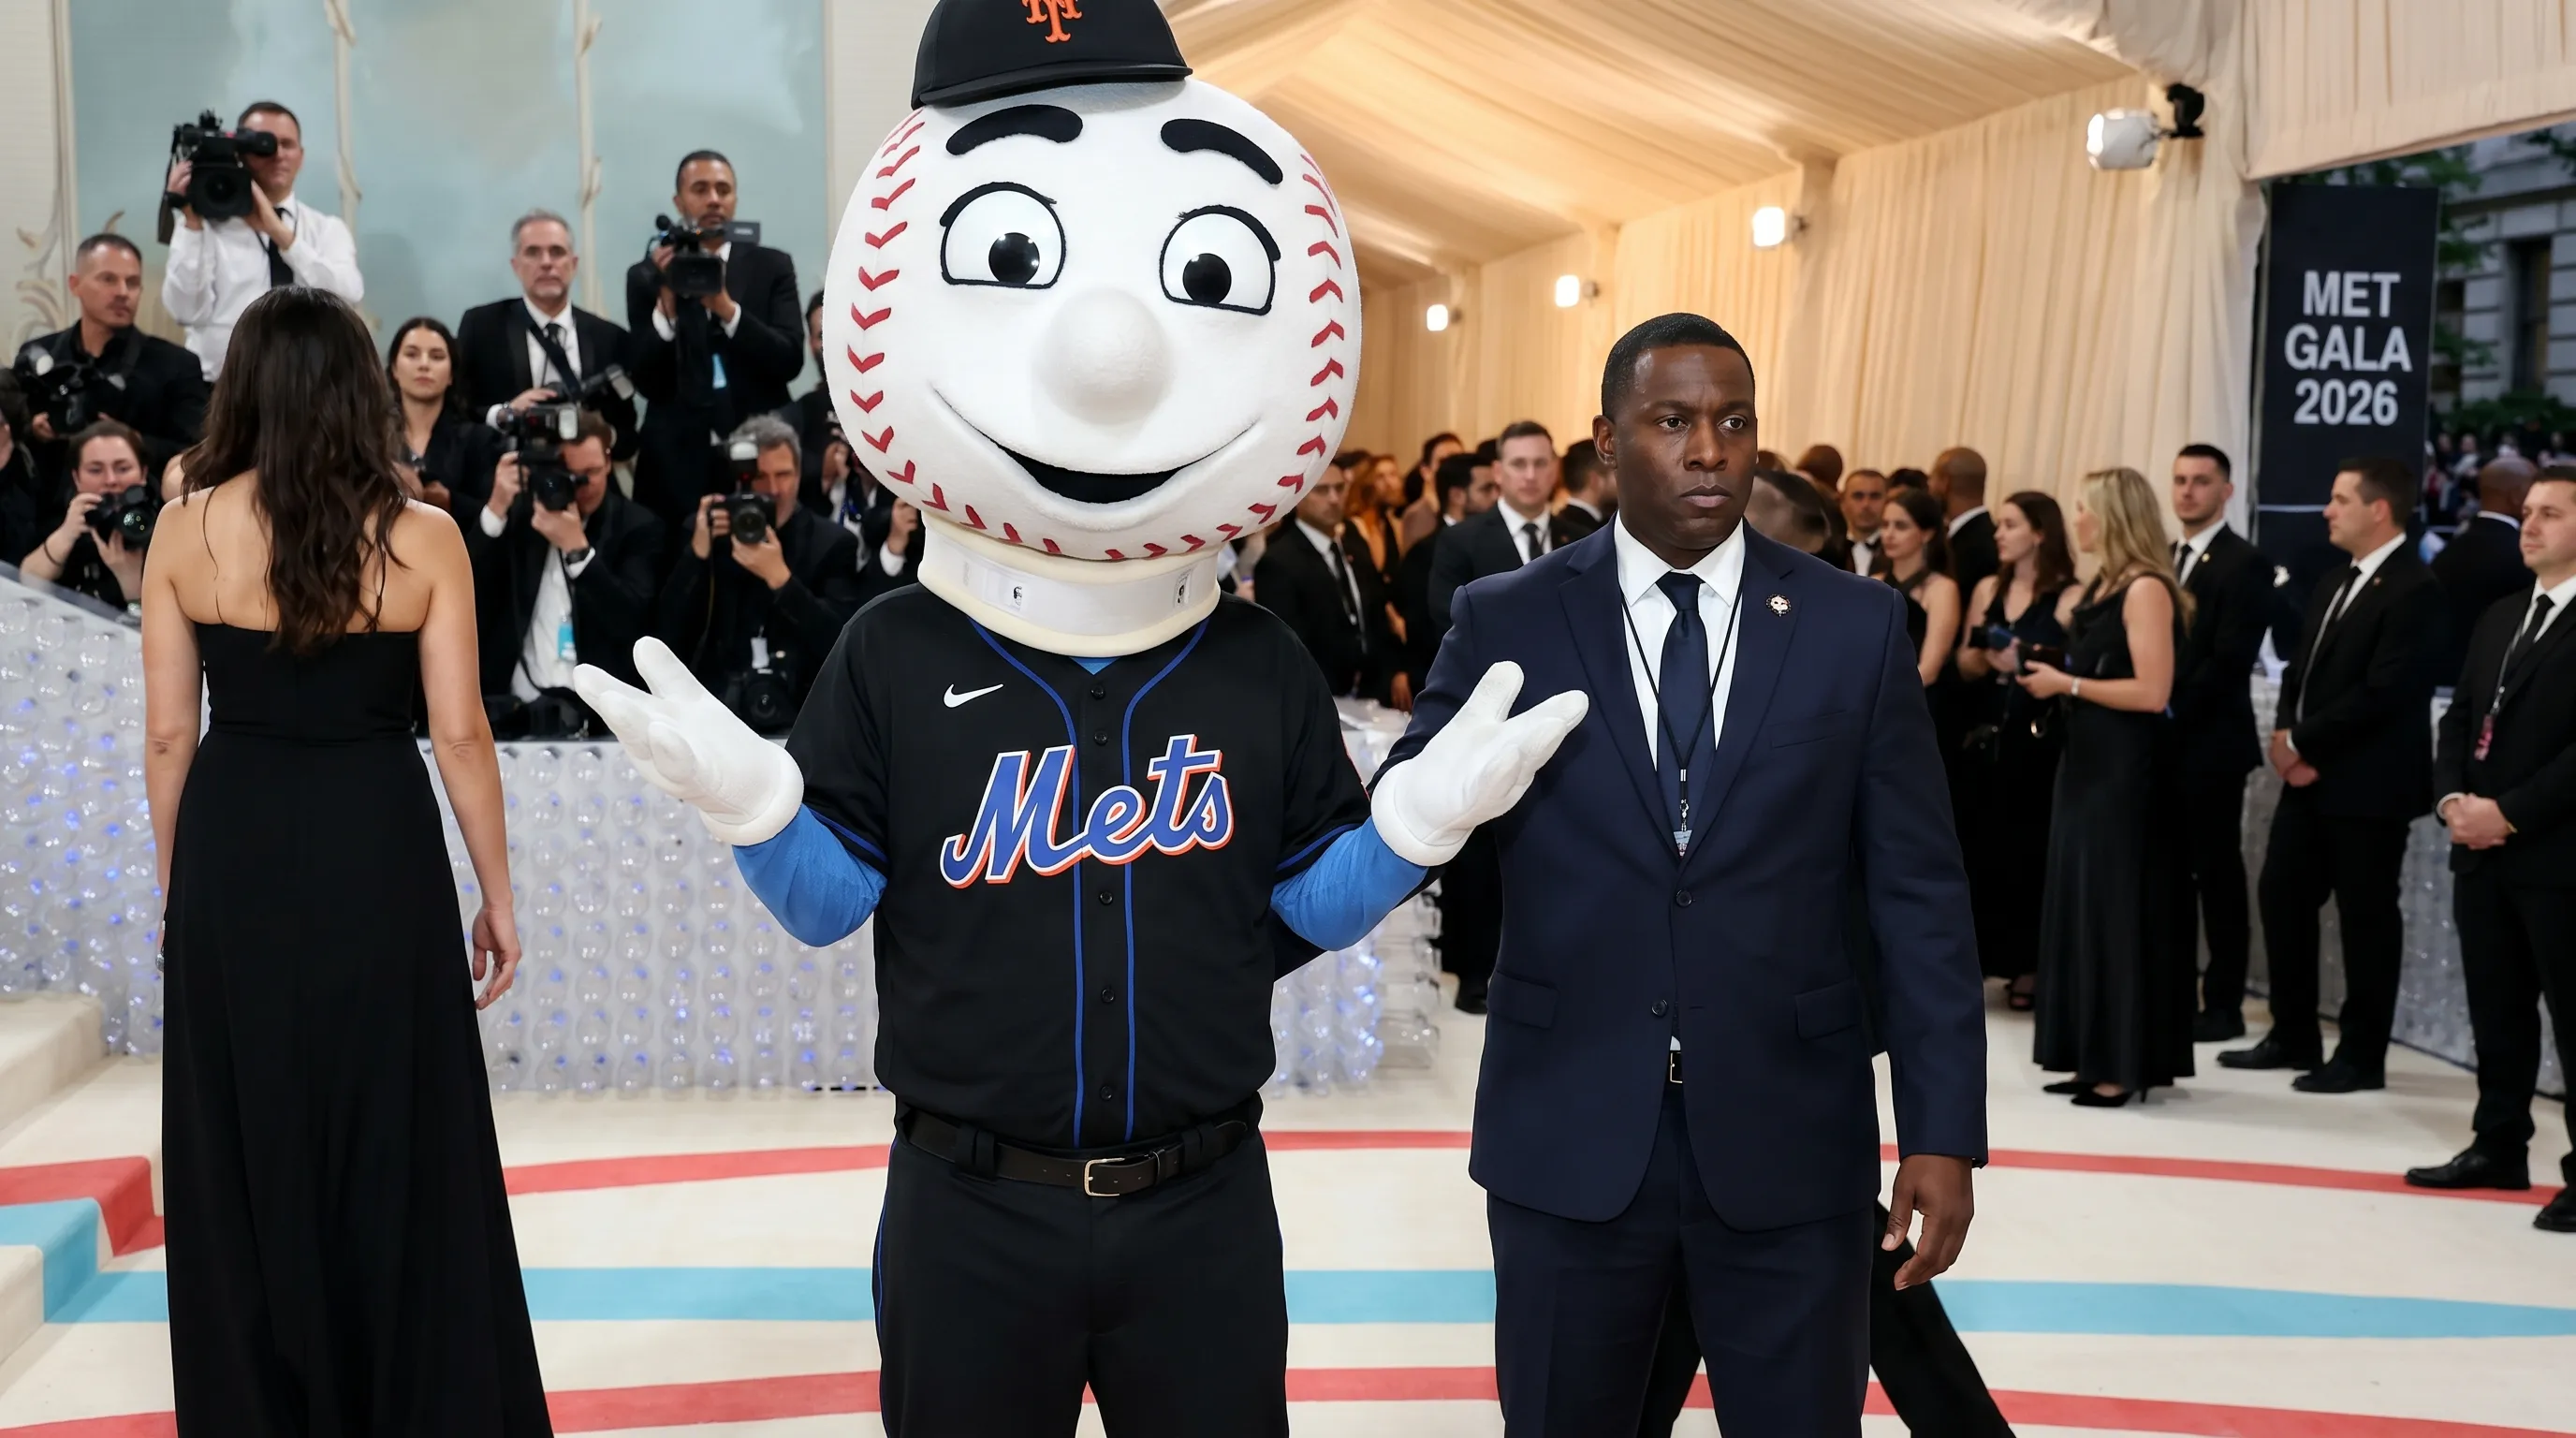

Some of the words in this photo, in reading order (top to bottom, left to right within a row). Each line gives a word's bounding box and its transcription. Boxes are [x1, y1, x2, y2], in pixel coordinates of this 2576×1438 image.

[2304, 271, 2400, 317] MET
[2285, 323, 2412, 372] GALA
[2294, 378, 2398, 426] 2026
[940, 734, 1234, 888] Mets
